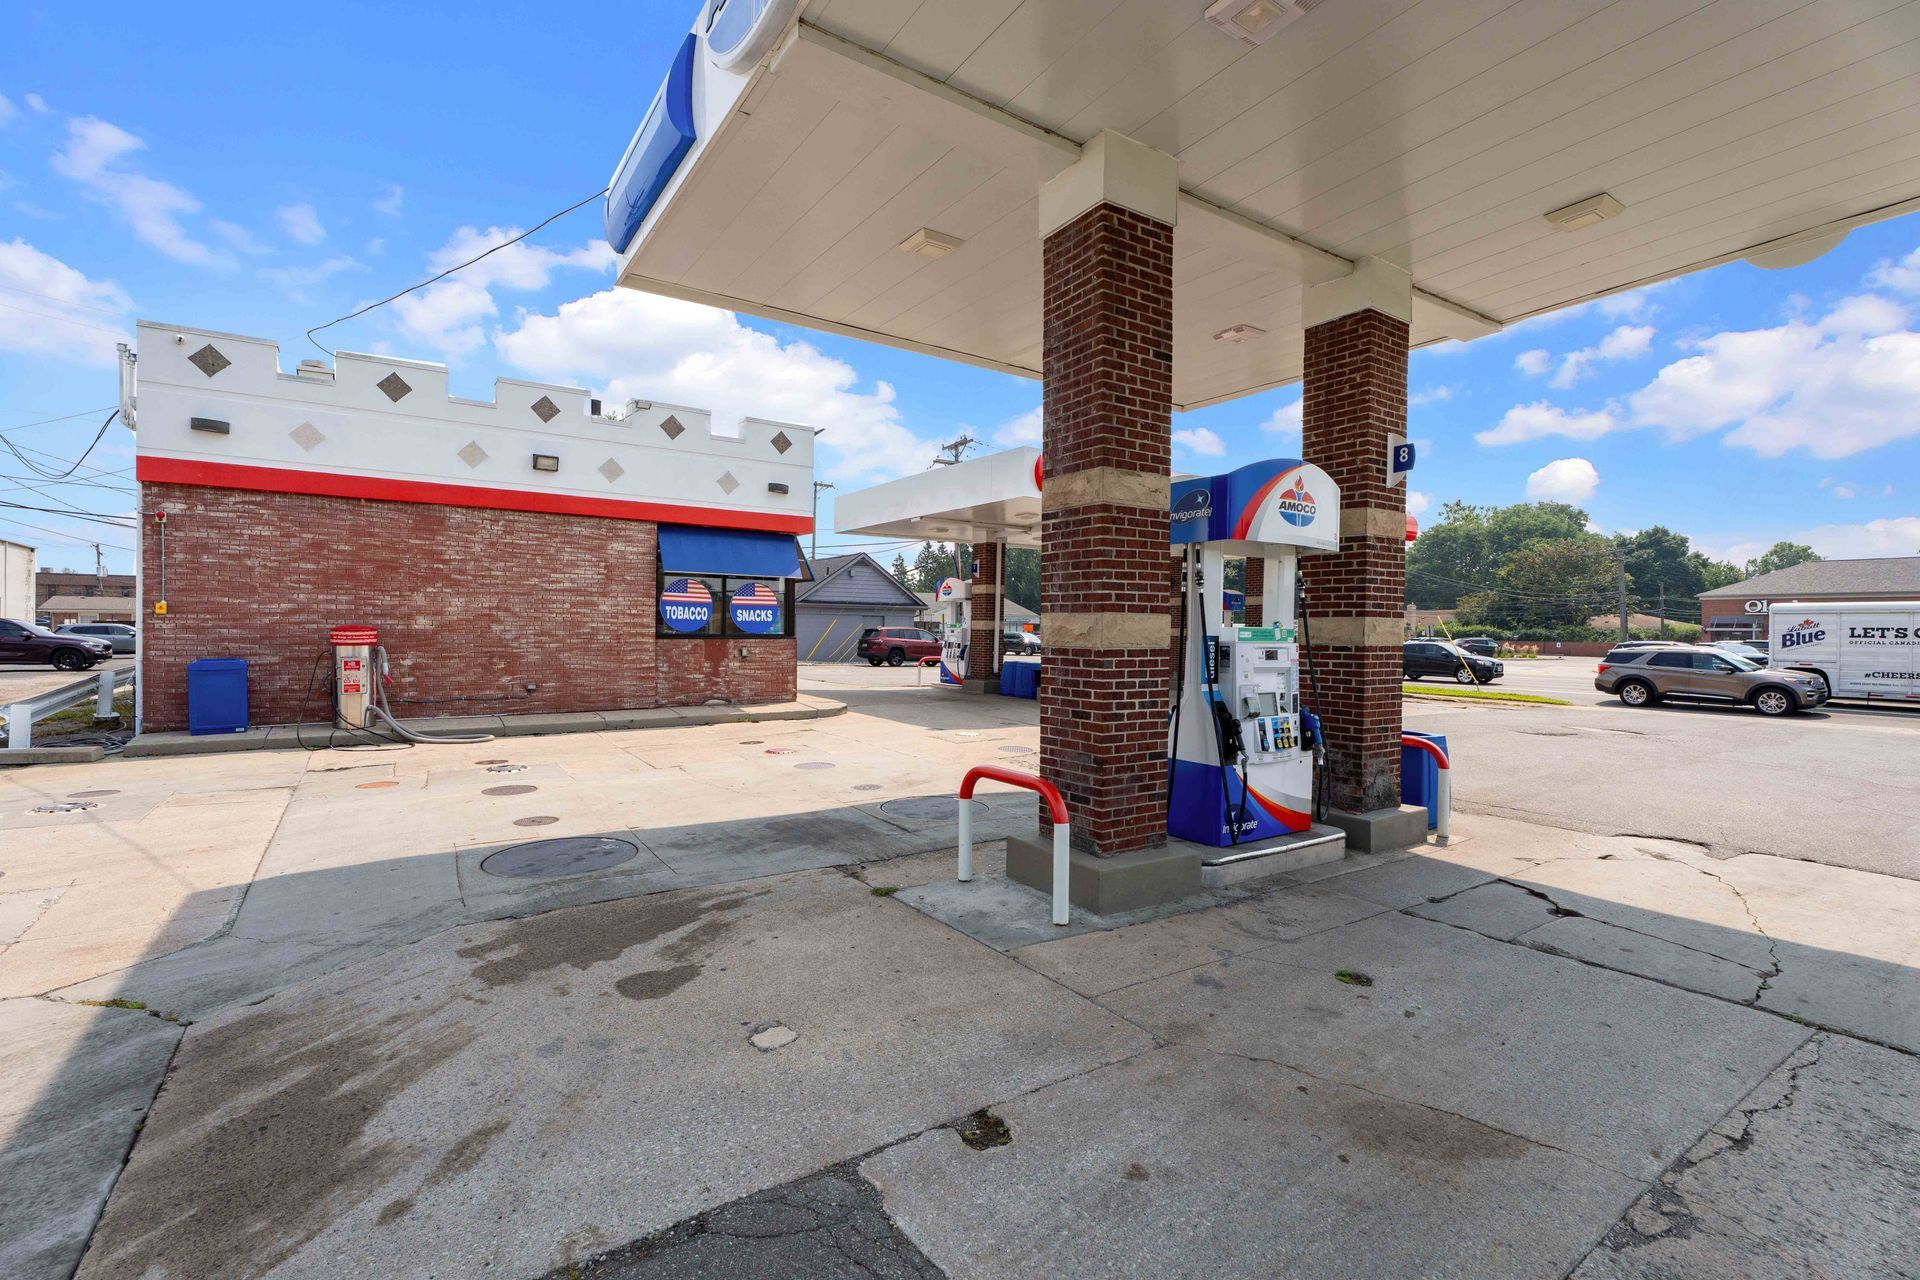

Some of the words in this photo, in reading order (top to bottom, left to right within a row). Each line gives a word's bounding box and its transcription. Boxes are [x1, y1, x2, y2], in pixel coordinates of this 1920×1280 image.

[1399, 447, 1409, 463] 8
[1169, 507, 1211, 522] nvigorate
[1278, 500, 1317, 515] AMOCO
[665, 605, 708, 621] TOBACCO
[736, 609, 773, 622] SNACKS
[1786, 621, 1821, 633] Labatt
[1849, 627, 1909, 639] LET'S
[1781, 629, 1826, 649] Blue
[1222, 820, 1258, 834] Inirate
